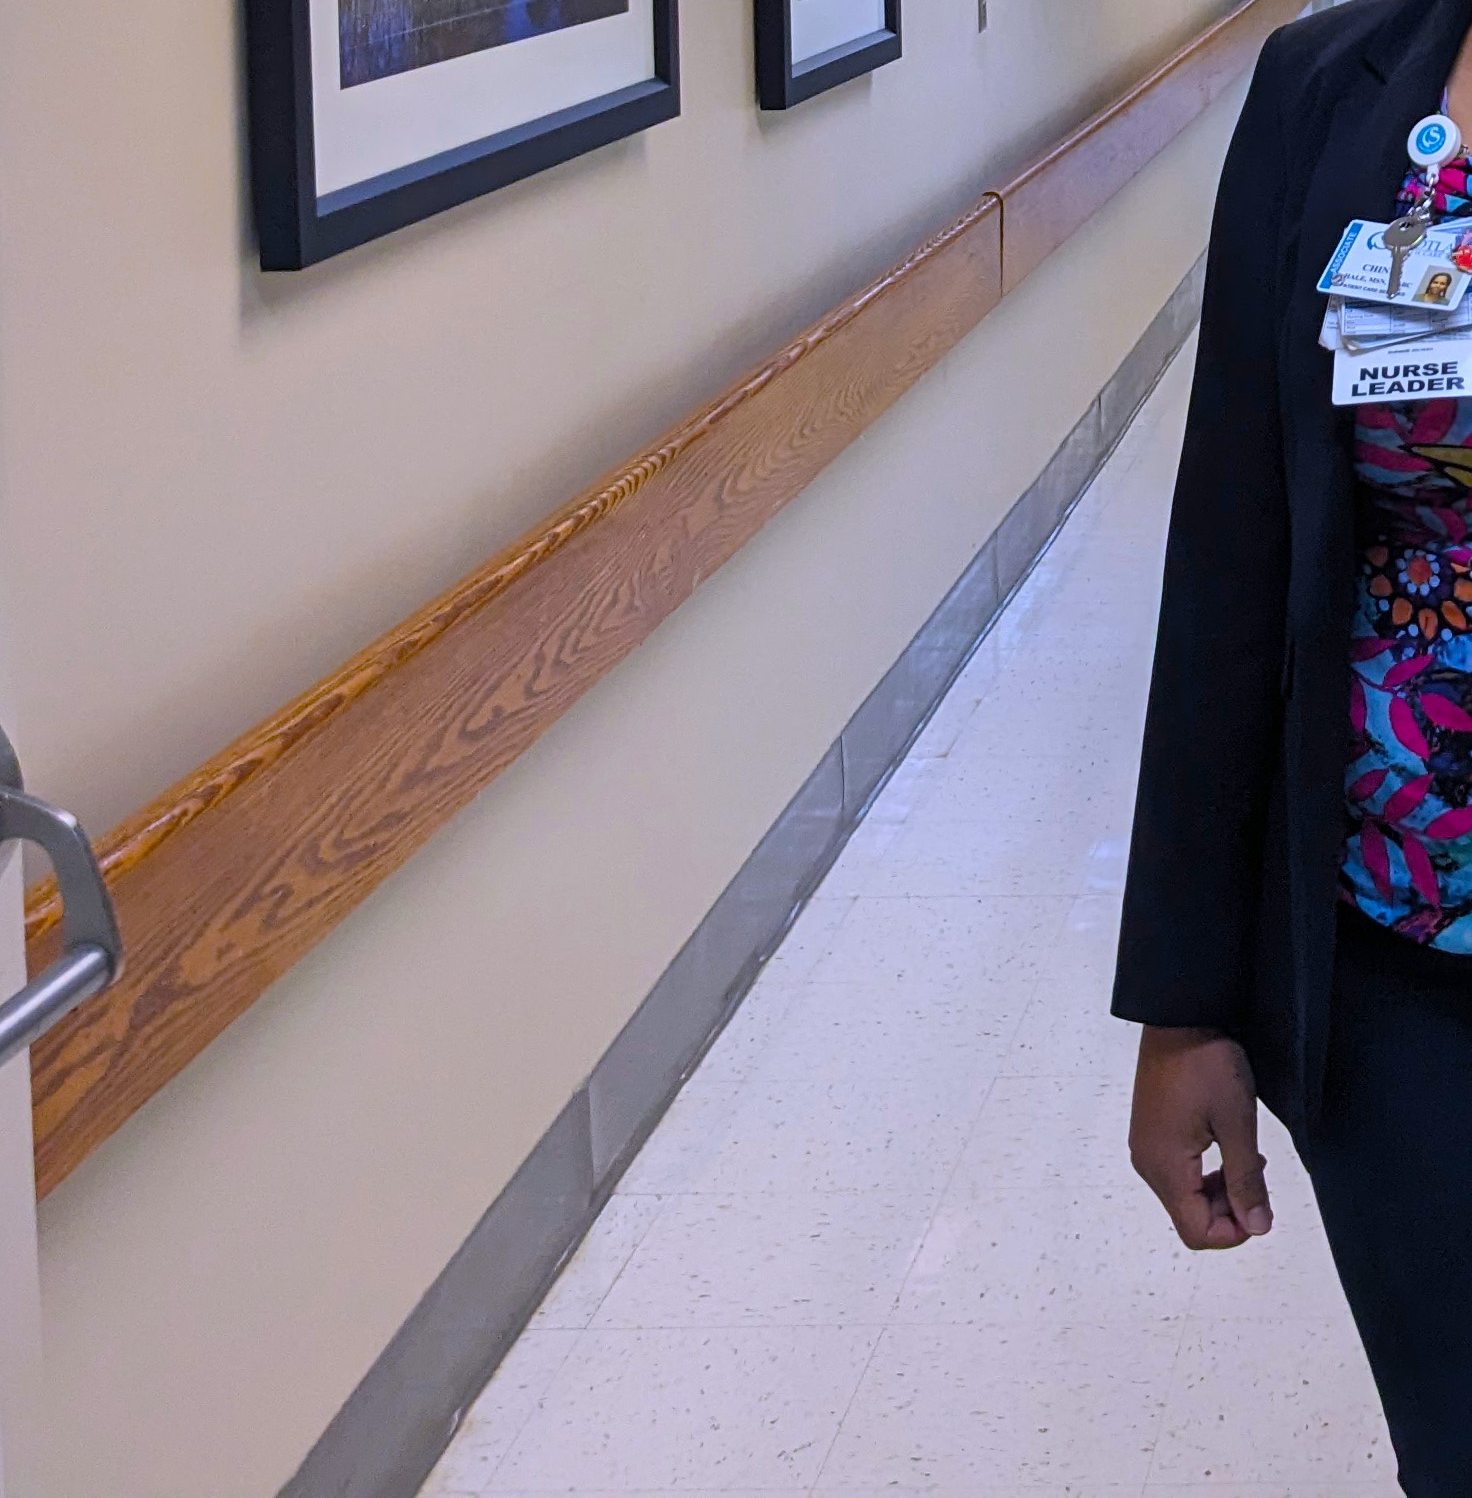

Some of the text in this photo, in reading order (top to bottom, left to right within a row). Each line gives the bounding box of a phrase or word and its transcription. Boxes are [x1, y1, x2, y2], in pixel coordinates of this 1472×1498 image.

[1330, 231, 1358, 274] ASSOCIATE
[1359, 361, 1459, 382] NURSE
[1351, 376, 1466, 397] LEADER
